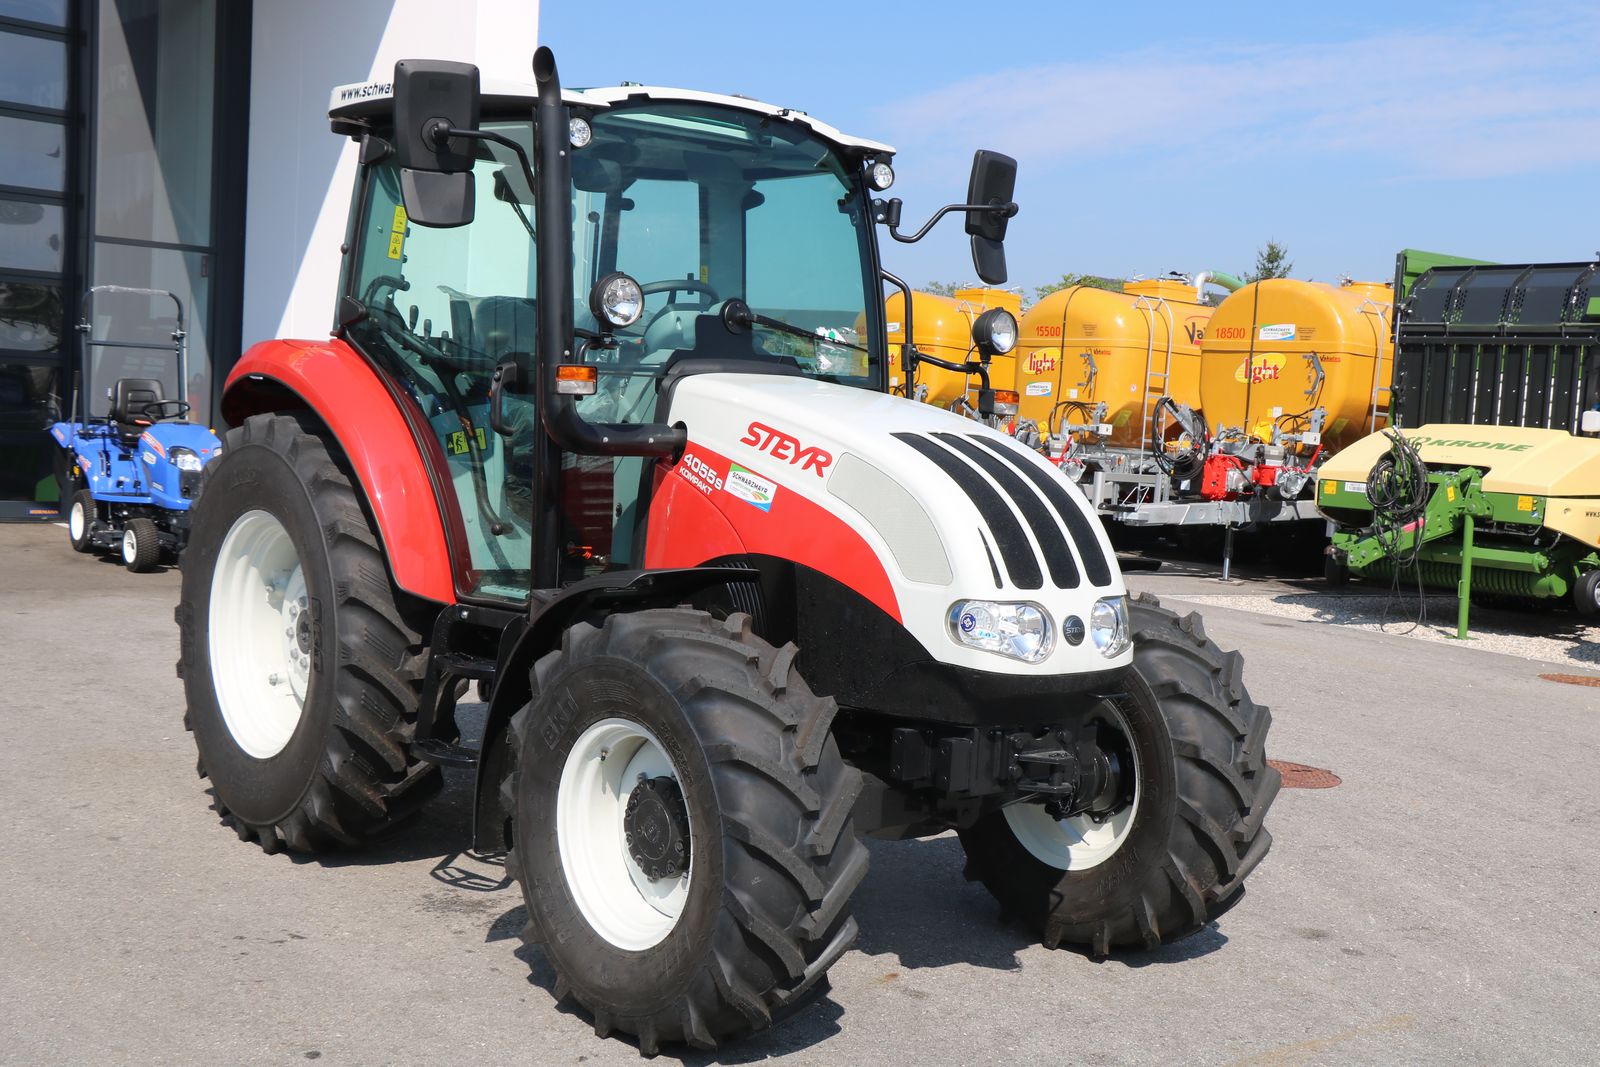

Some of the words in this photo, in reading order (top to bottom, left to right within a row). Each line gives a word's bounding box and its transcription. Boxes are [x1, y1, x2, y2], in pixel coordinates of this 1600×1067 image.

[1036, 326, 1061, 337] 15500
[1215, 327, 1246, 339] 18500
[1029, 352, 1056, 375] light
[1244, 358, 1279, 384] lght
[740, 421, 833, 478] STEYR
[1428, 439, 1535, 452] KRONE
[679, 466, 713, 496] KOMPAKT
[732, 471, 768, 494] SCHWARZMAYR
